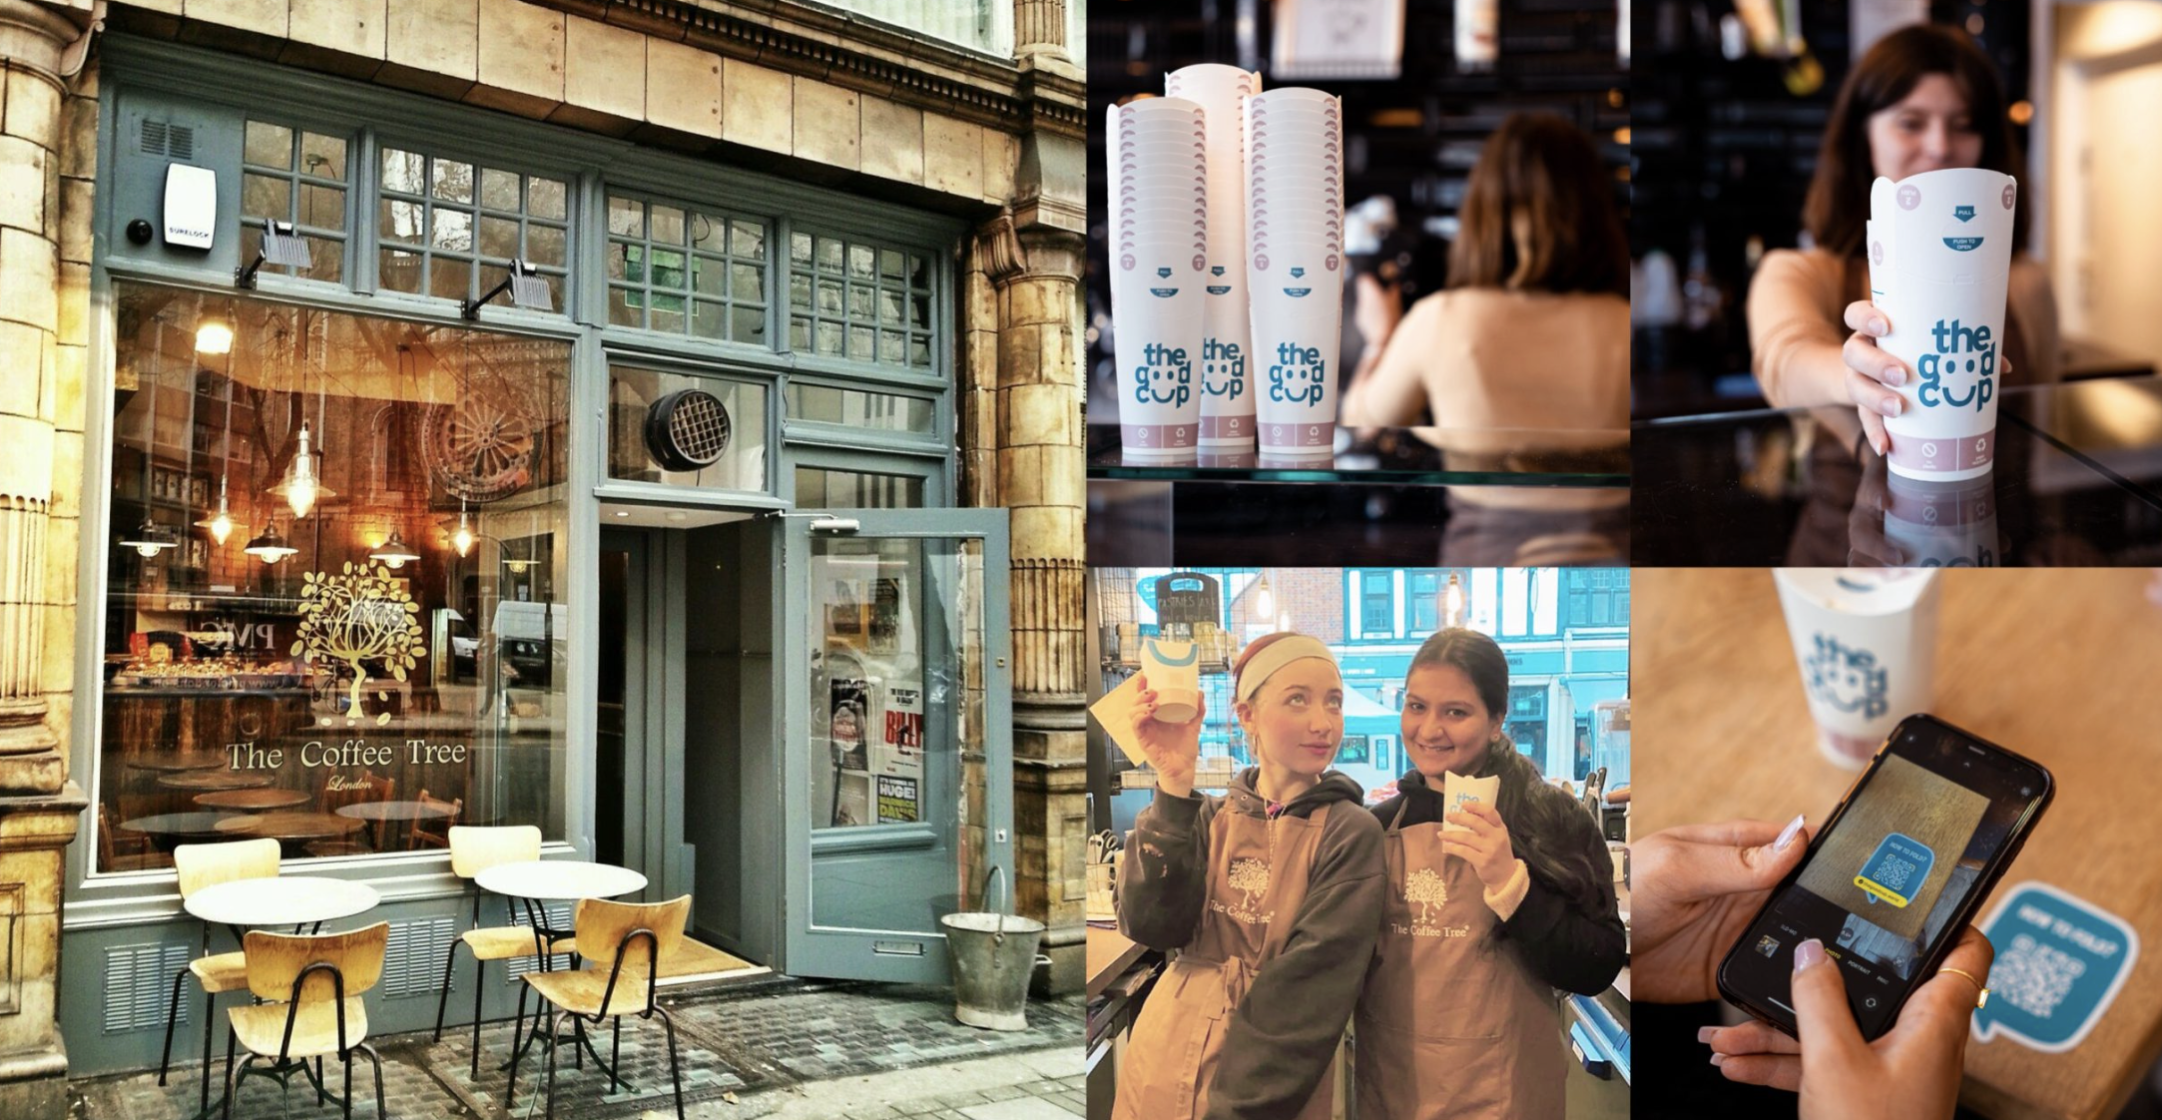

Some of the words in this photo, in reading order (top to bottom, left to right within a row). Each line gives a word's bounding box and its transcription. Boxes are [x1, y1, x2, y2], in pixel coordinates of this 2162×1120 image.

[169, 226, 210, 238] SURELOCK
[1931, 319, 1991, 354] the
[1143, 343, 1187, 366] the
[1276, 342, 1320, 365] the
[1918, 341, 1996, 381] good
[1135, 360, 1191, 387] good
[1269, 360, 1325, 386] good
[1135, 384, 1190, 409] cup
[1200, 378, 1243, 401] up
[1269, 383, 1324, 408] cup
[1918, 377, 1993, 413] cup
[885, 710, 923, 748] BILLY
[226, 742, 283, 770] The
[300, 740, 392, 768] Coffee
[406, 739, 466, 764] Tree
[326, 775, 372, 792] London
[879, 784, 916, 800] HUGE!
[1889, 842, 1903, 851] HOW
[1902, 847, 1911, 855] TO
[1909, 851, 1928, 863] FOLD?
[1209, 900, 1226, 913] The
[1227, 905, 1256, 925] Coffee
[2017, 903, 2053, 929] HOW
[2050, 919, 2073, 939] TO
[1391, 923, 1408, 935] The
[1410, 925, 1441, 937] Coffee
[1443, 926, 1467, 937] Tree
[1824, 947, 1841, 959] PHOTO
[1847, 960, 1871, 975] PORTRAIT
